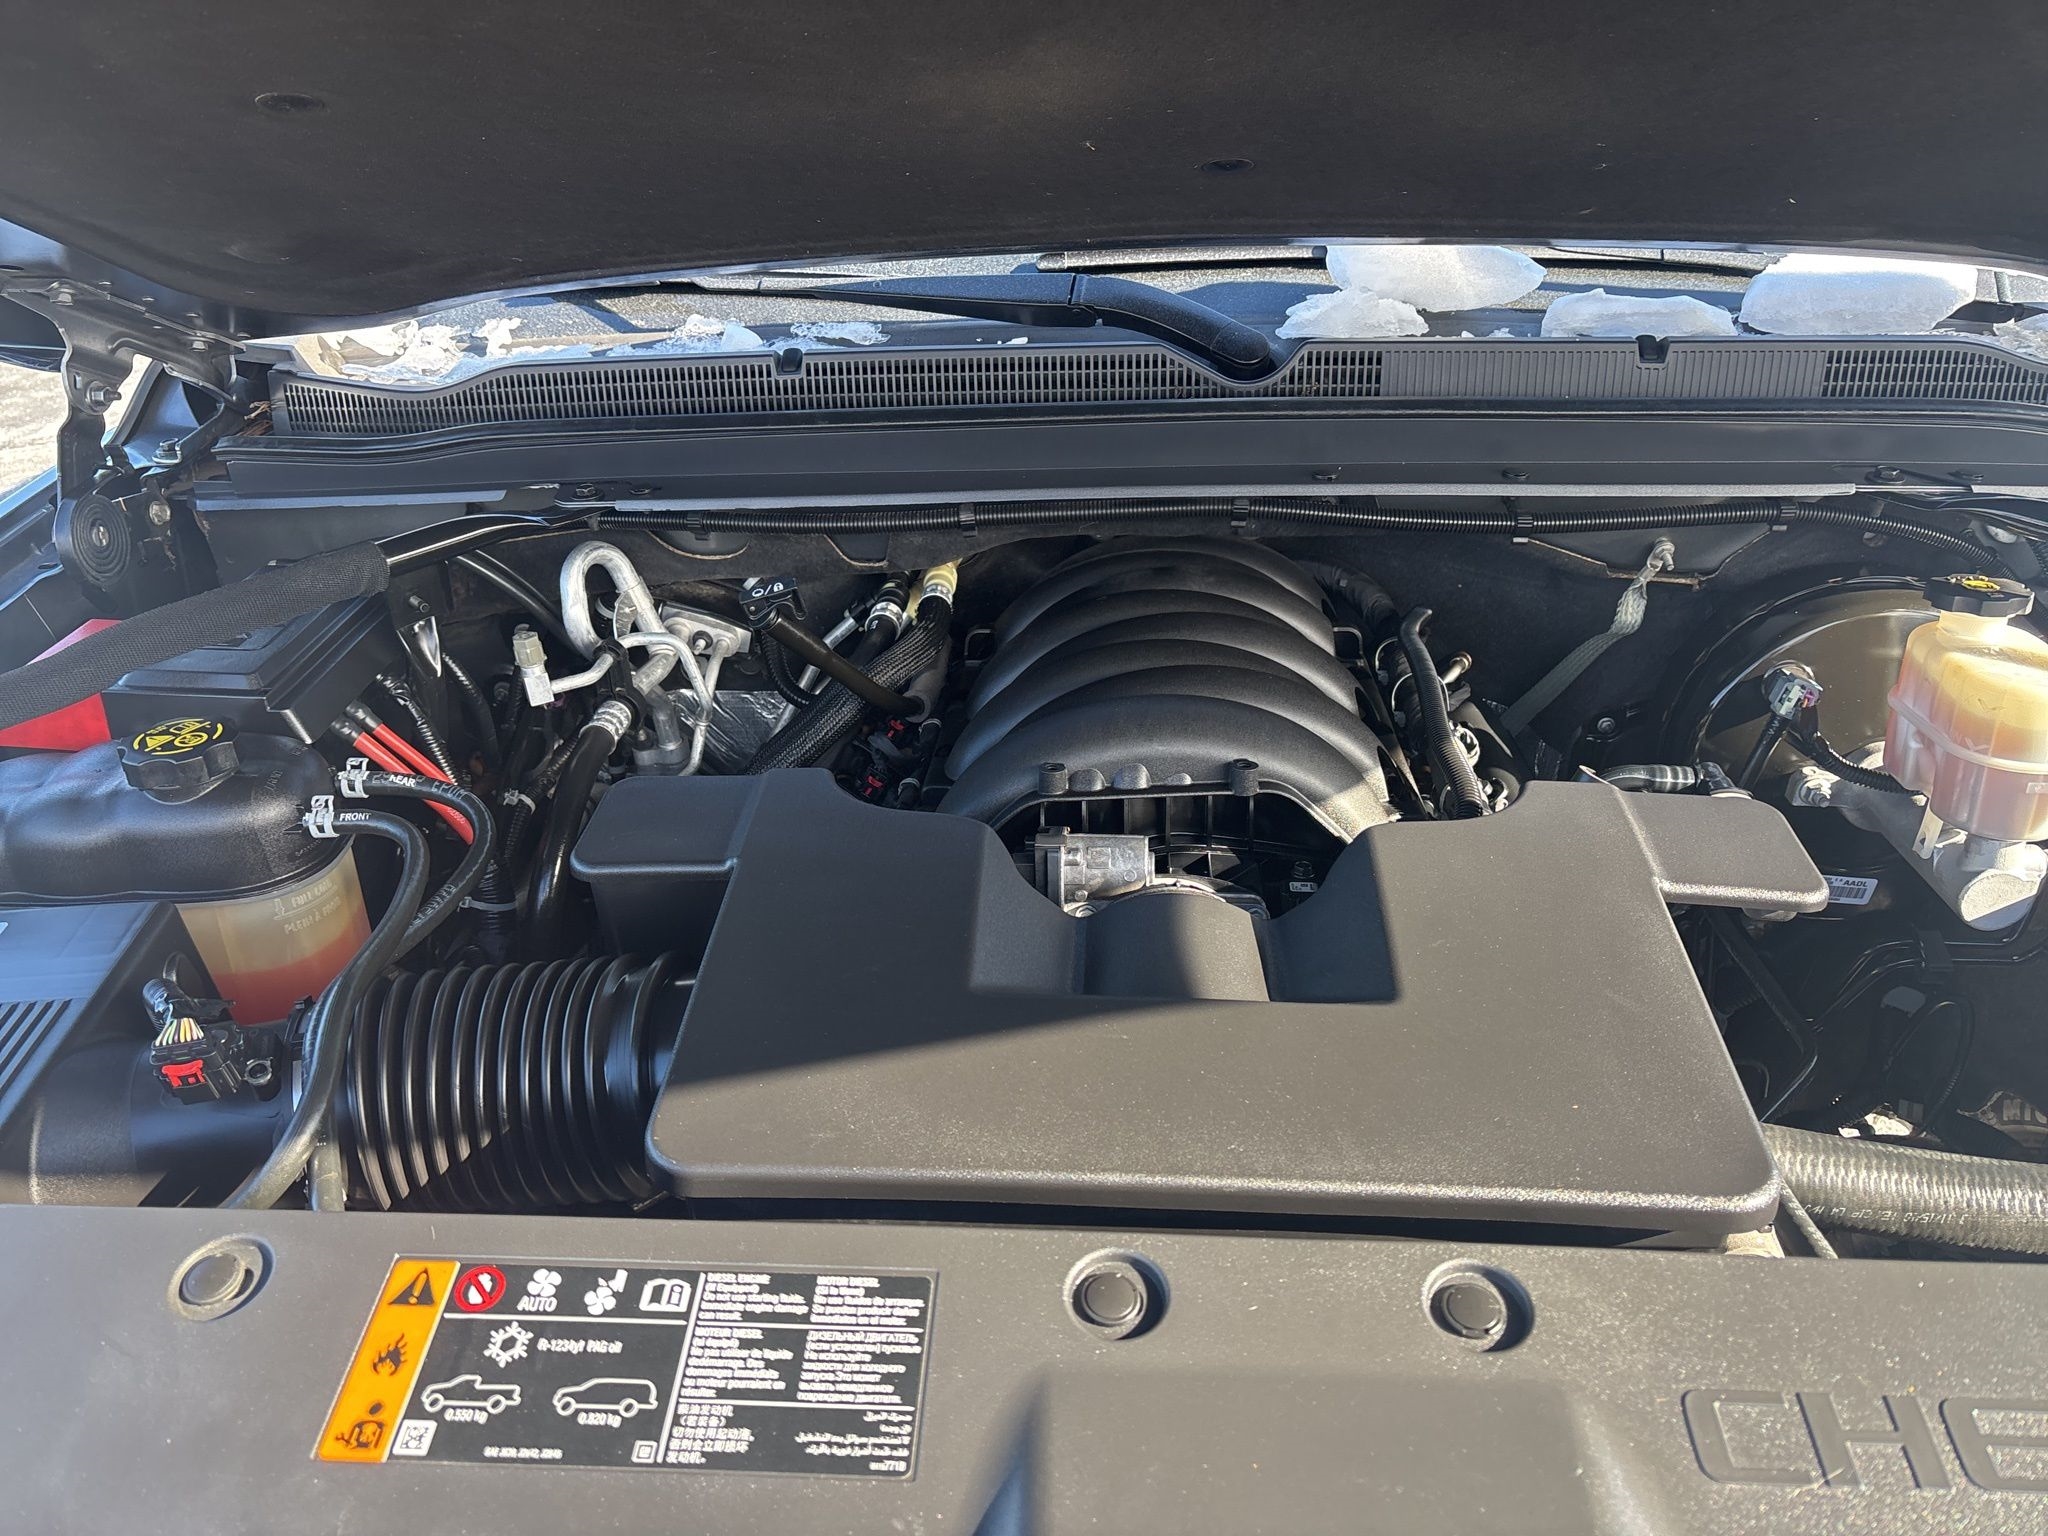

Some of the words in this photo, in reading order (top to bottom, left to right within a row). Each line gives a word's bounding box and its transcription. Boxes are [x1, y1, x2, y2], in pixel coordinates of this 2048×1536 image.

[339, 812, 372, 822] FRONT
[1842, 880, 1868, 888] AADL
[517, 1296, 558, 1312] AUTO
[807, 1331, 865, 1342] ДИЗЕЛЬНЫЙ
[865, 1333, 919, 1343] ДВИГАТЕЛЬ
[587, 1339, 608, 1352] PAG
[445, 1408, 473, 1422] 0.550
[474, 1410, 489, 1425] kg
[678, 1404, 733, 1416] 柴油发动机
[577, 1412, 606, 1425] 0.820
[605, 1414, 622, 1428] kg
[1681, 1388, 2048, 1494] CHE
